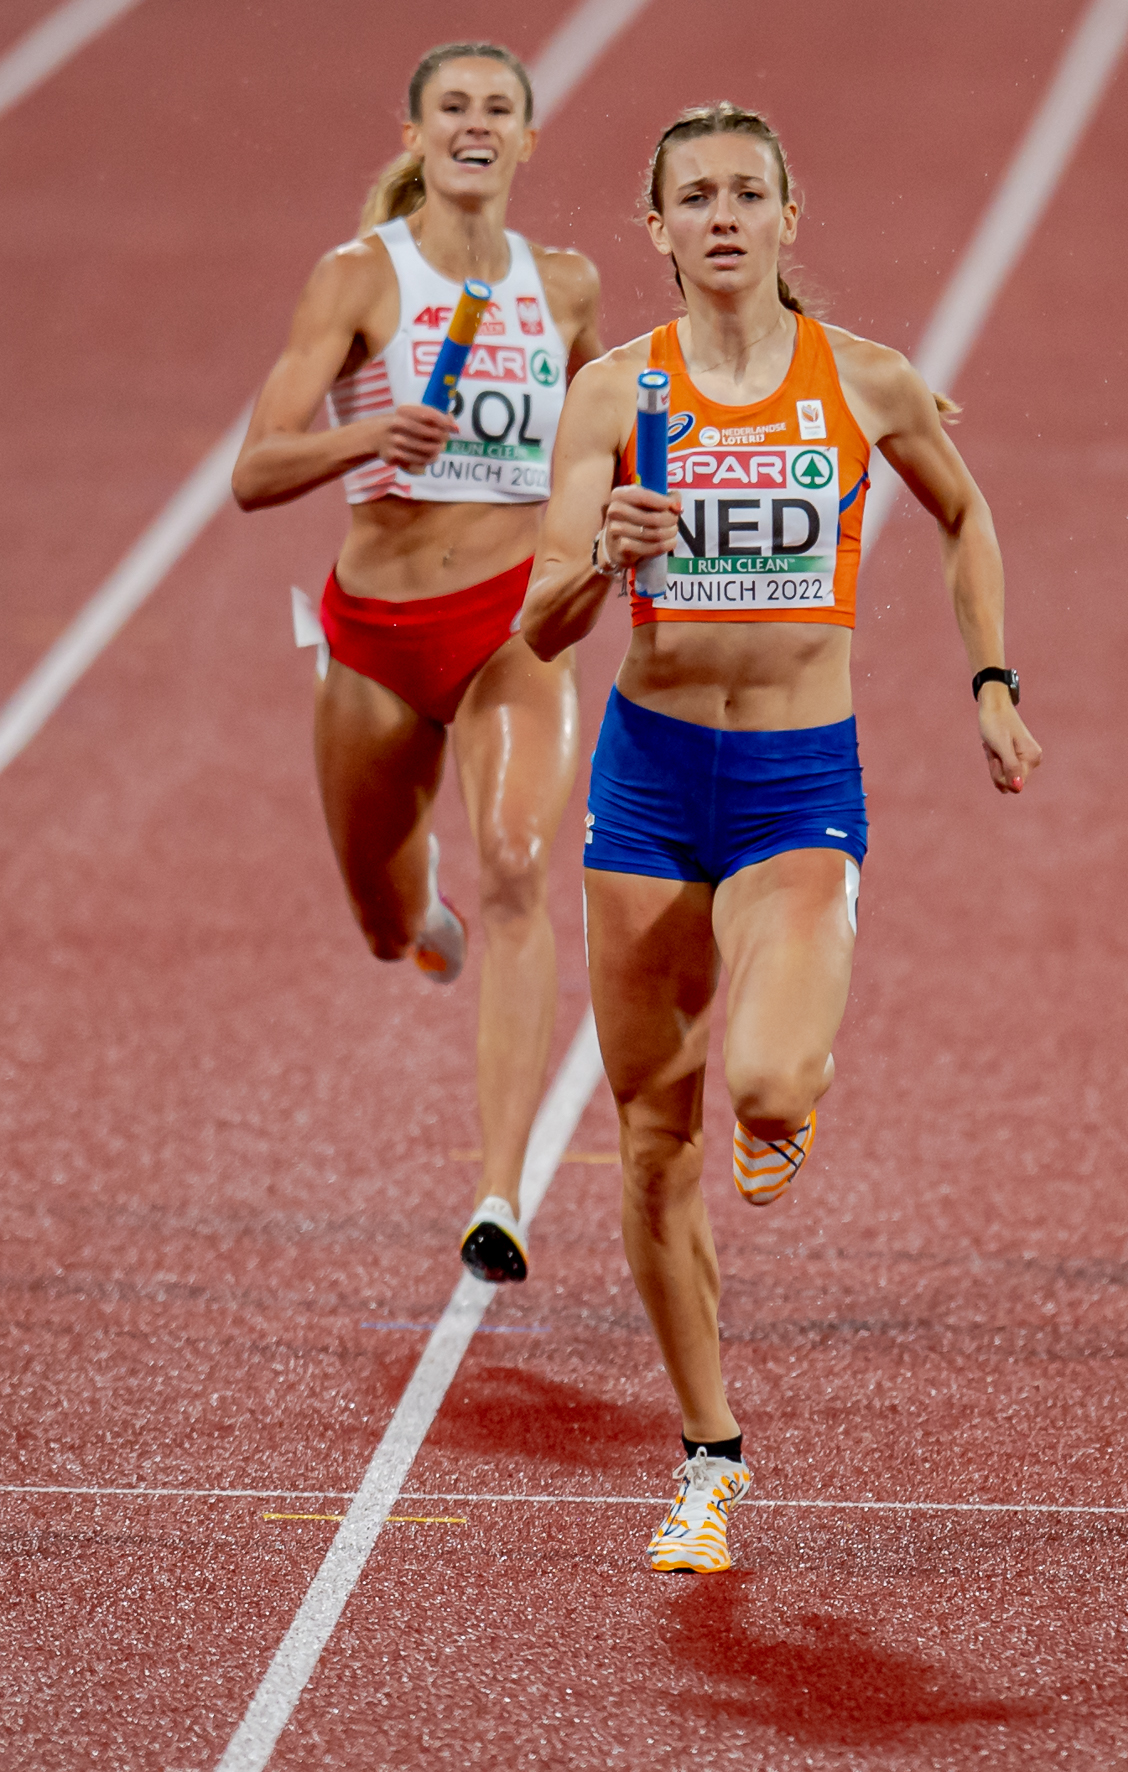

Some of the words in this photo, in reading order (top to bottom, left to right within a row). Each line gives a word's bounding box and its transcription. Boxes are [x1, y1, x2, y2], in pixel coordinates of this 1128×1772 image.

[415, 344, 525, 379] SAR
[721, 422, 787, 437] NEDERLANDSE
[722, 434, 765, 445] LOTERIJ
[427, 461, 502, 483] UNICH
[667, 498, 820, 558] NED
[698, 559, 732, 573] RUN
[665, 580, 756, 601] MUNICH
[767, 578, 823, 600] 2022
